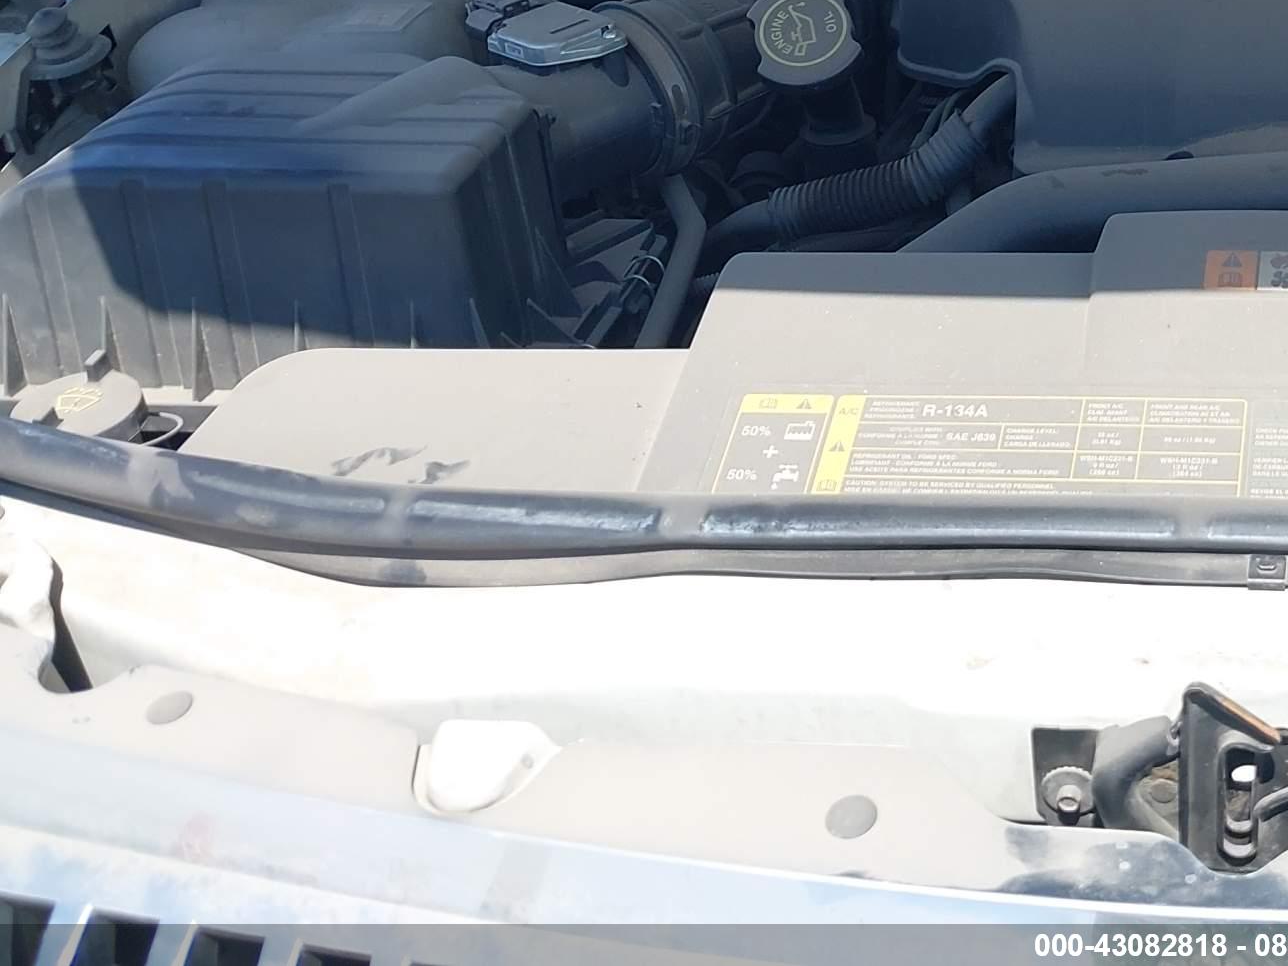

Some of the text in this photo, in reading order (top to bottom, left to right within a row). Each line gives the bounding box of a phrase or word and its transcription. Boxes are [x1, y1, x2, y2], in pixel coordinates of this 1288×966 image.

[823, 10, 838, 33] OIL
[769, 9, 794, 55] ENGINE
[922, 403, 989, 418] R-134A
[946, 433, 968, 442] SAE
[726, 468, 759, 482] 50%
